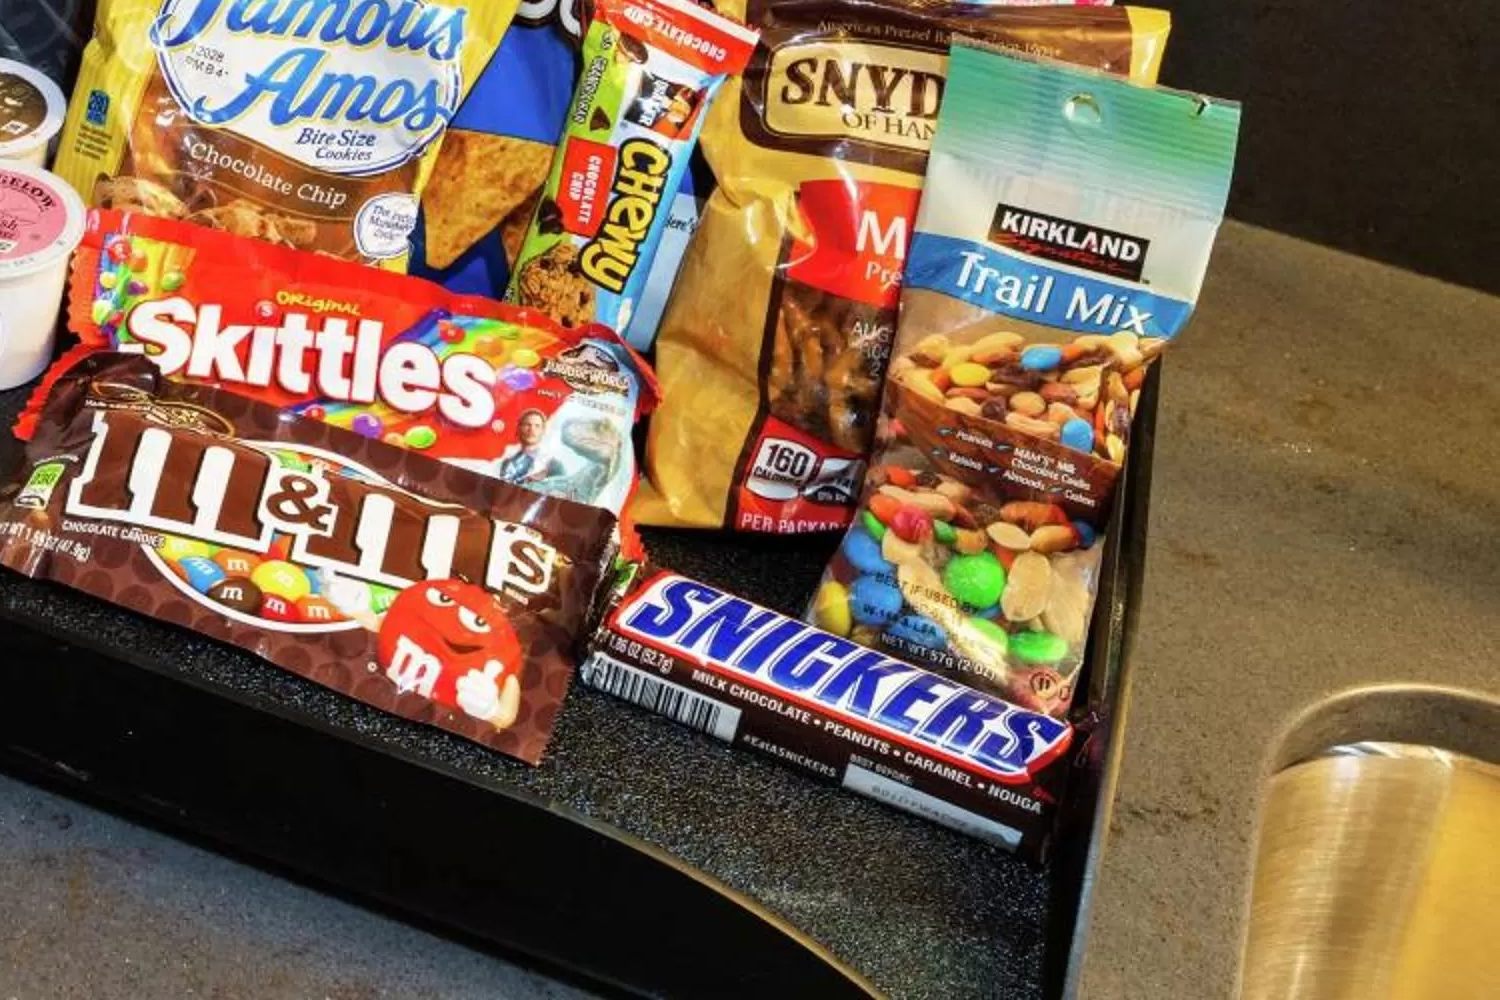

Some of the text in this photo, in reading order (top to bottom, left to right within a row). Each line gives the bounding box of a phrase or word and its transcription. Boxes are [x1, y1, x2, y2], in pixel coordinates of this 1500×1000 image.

[655, 17, 727, 62] CHOCOLATE
[192, 48, 454, 132] Amos
[782, 57, 947, 120] SNYD
[297, 127, 377, 147] Bite Size
[842, 112, 877, 131] OF
[190, 142, 347, 209] Chocolate Chip
[315, 147, 372, 162] Cookies
[578, 154, 603, 226] CHOCOLATE
[1000, 210, 1141, 263] KIRKLAND
[960, 251, 1153, 335] Trail Mix
[119, 296, 497, 430] Skittles
[766, 443, 810, 477] 160
[62, 519, 118, 537] CHOCOLATE
[741, 512, 773, 533] PER
[626, 580, 1069, 772] SNICKERS
[692, 667, 727, 692] MILK
[730, 684, 812, 726] CHOCOLATE
[824, 722, 891, 756] PEANUTS
[904, 752, 973, 789] CARAMEL
[989, 784, 1042, 815] NOUGA
